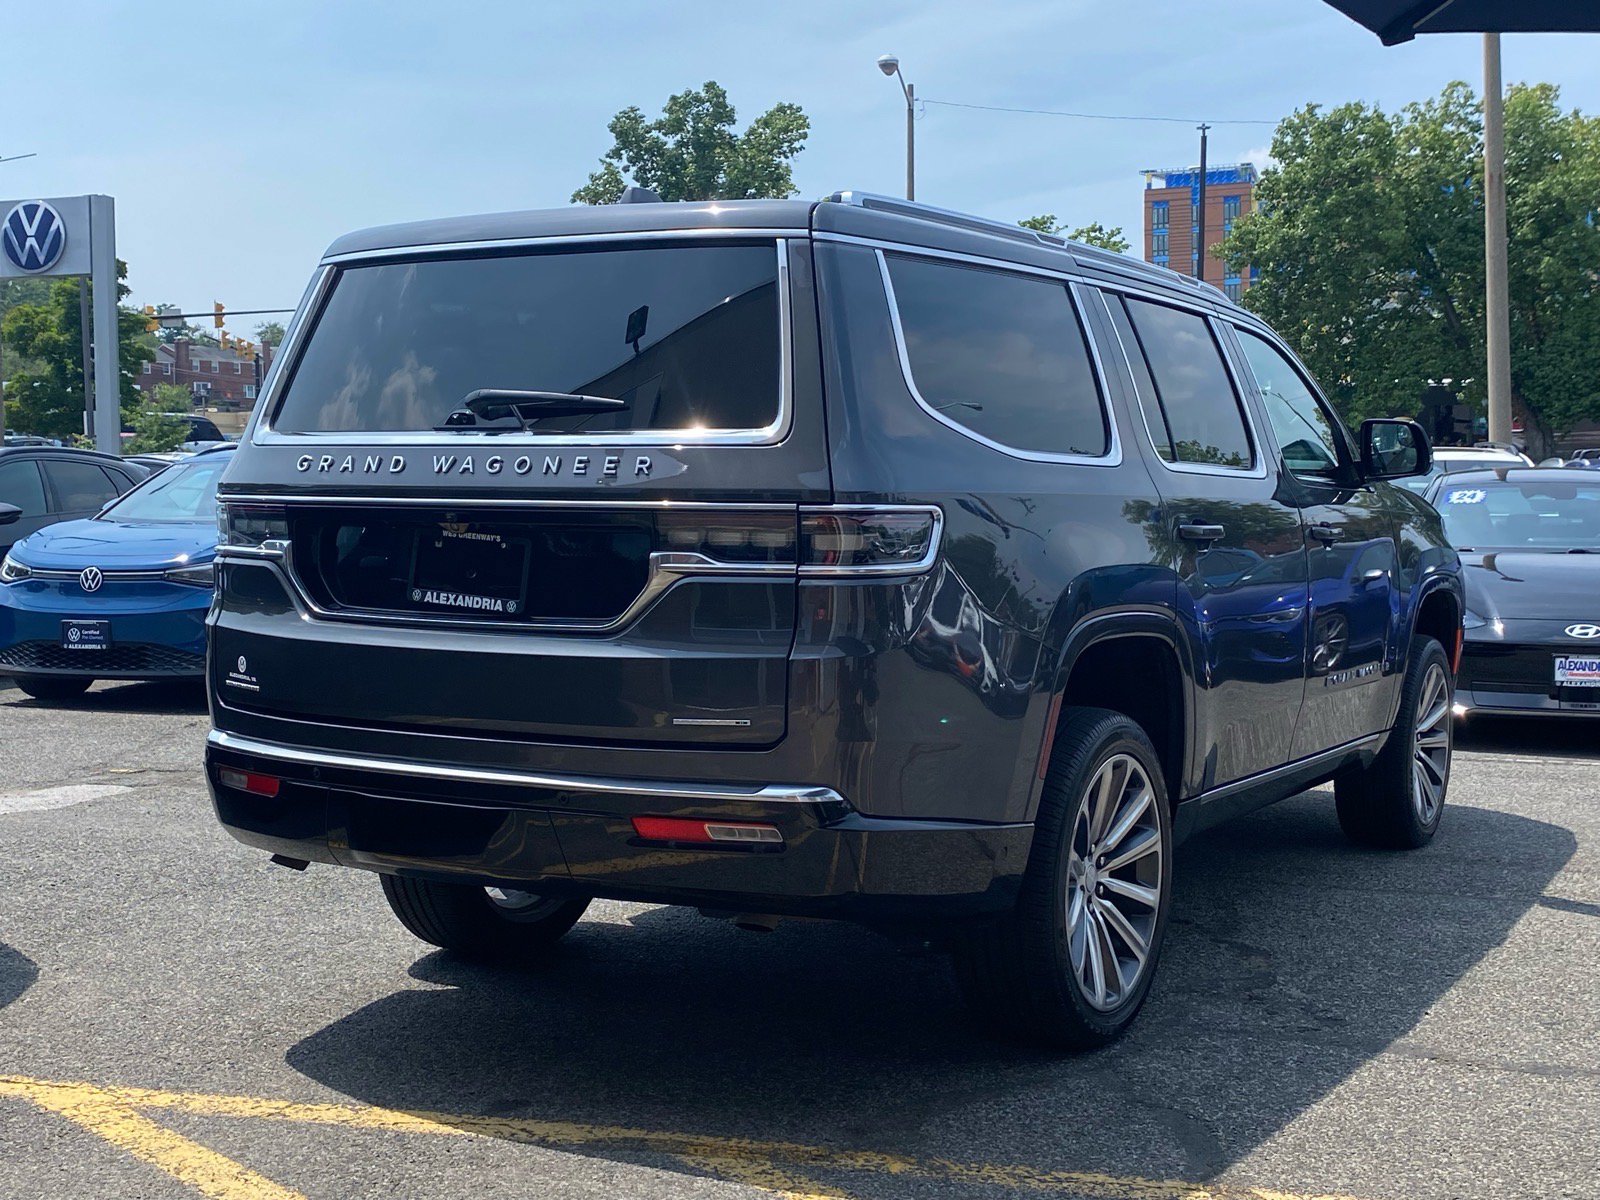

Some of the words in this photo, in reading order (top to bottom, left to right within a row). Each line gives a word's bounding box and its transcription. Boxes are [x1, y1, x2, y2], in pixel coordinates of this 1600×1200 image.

[1, 200, 66, 273] VW
[296, 454, 407, 473] GRAND
[432, 455, 653, 476] WAGONEER
[1456, 492, 1478, 500] 24
[424, 591, 503, 611] ALEXANDRIA
